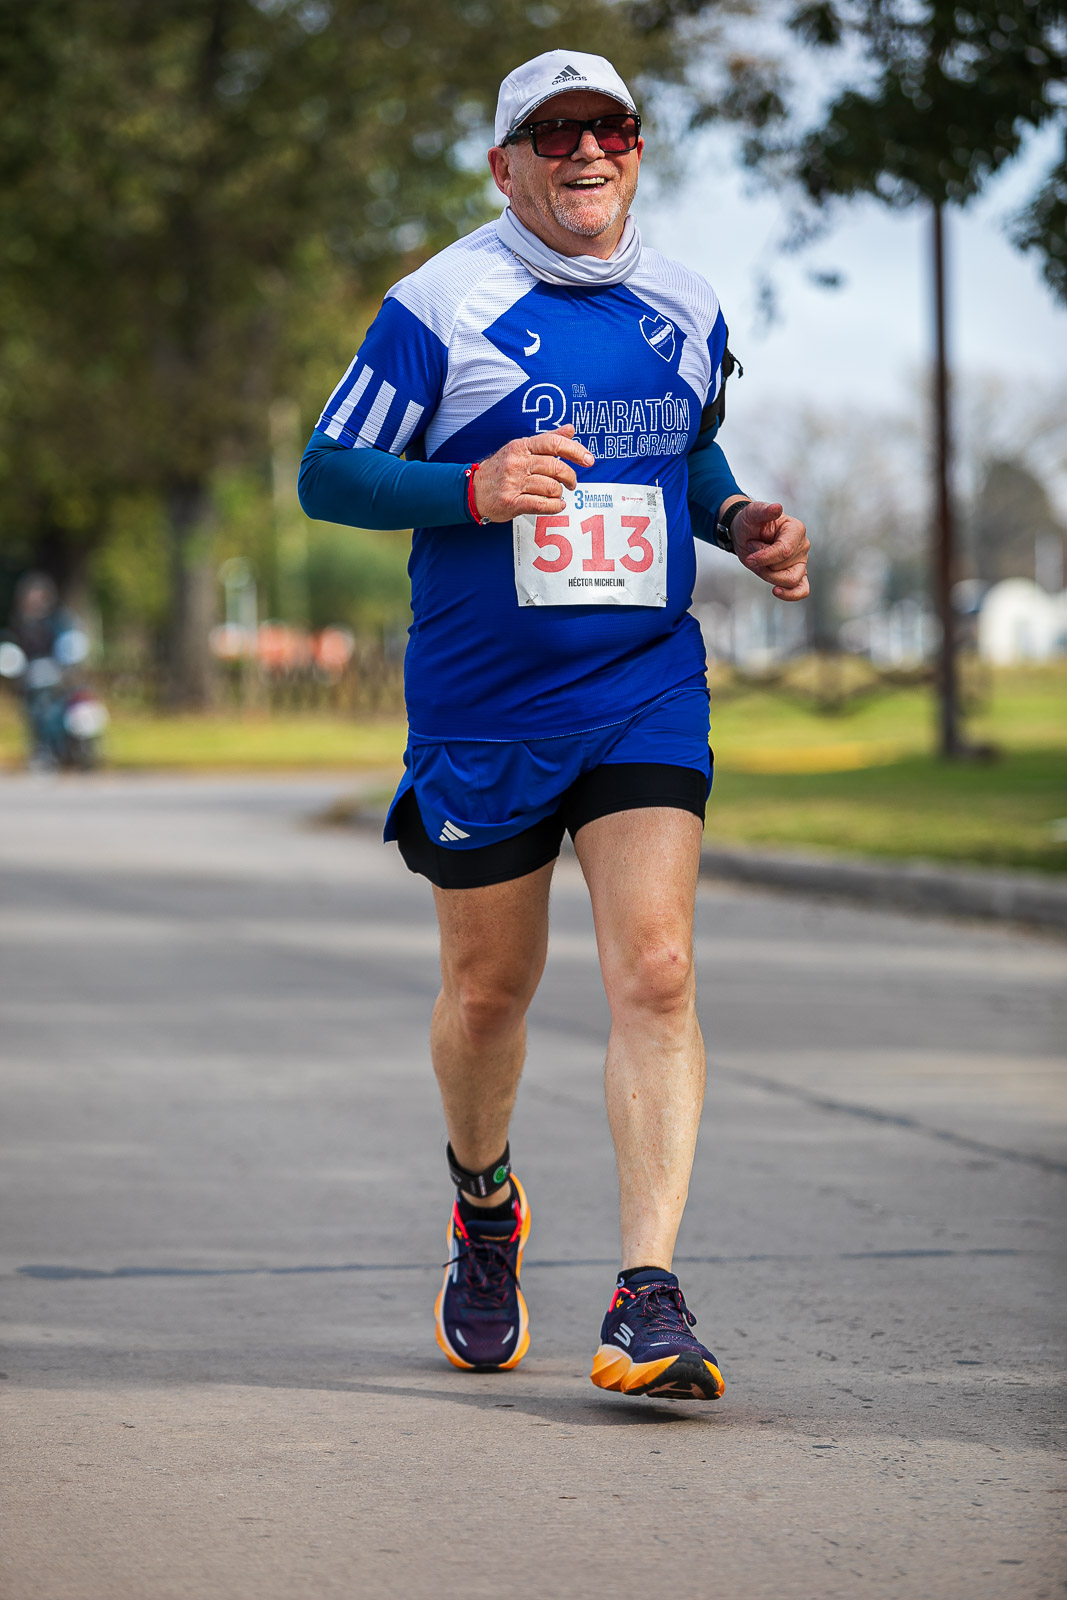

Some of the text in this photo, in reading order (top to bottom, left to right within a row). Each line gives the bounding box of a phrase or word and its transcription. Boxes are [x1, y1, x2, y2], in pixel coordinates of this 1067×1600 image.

[552, 76, 587, 85] adidas
[572, 392, 690, 434] MARATÓN
[574, 490, 584, 509] 3
[585, 493, 613, 502] MARATÓN
[532, 515, 654, 573] 513
[568, 577, 625, 587] HÉCTOR MICHELINI
